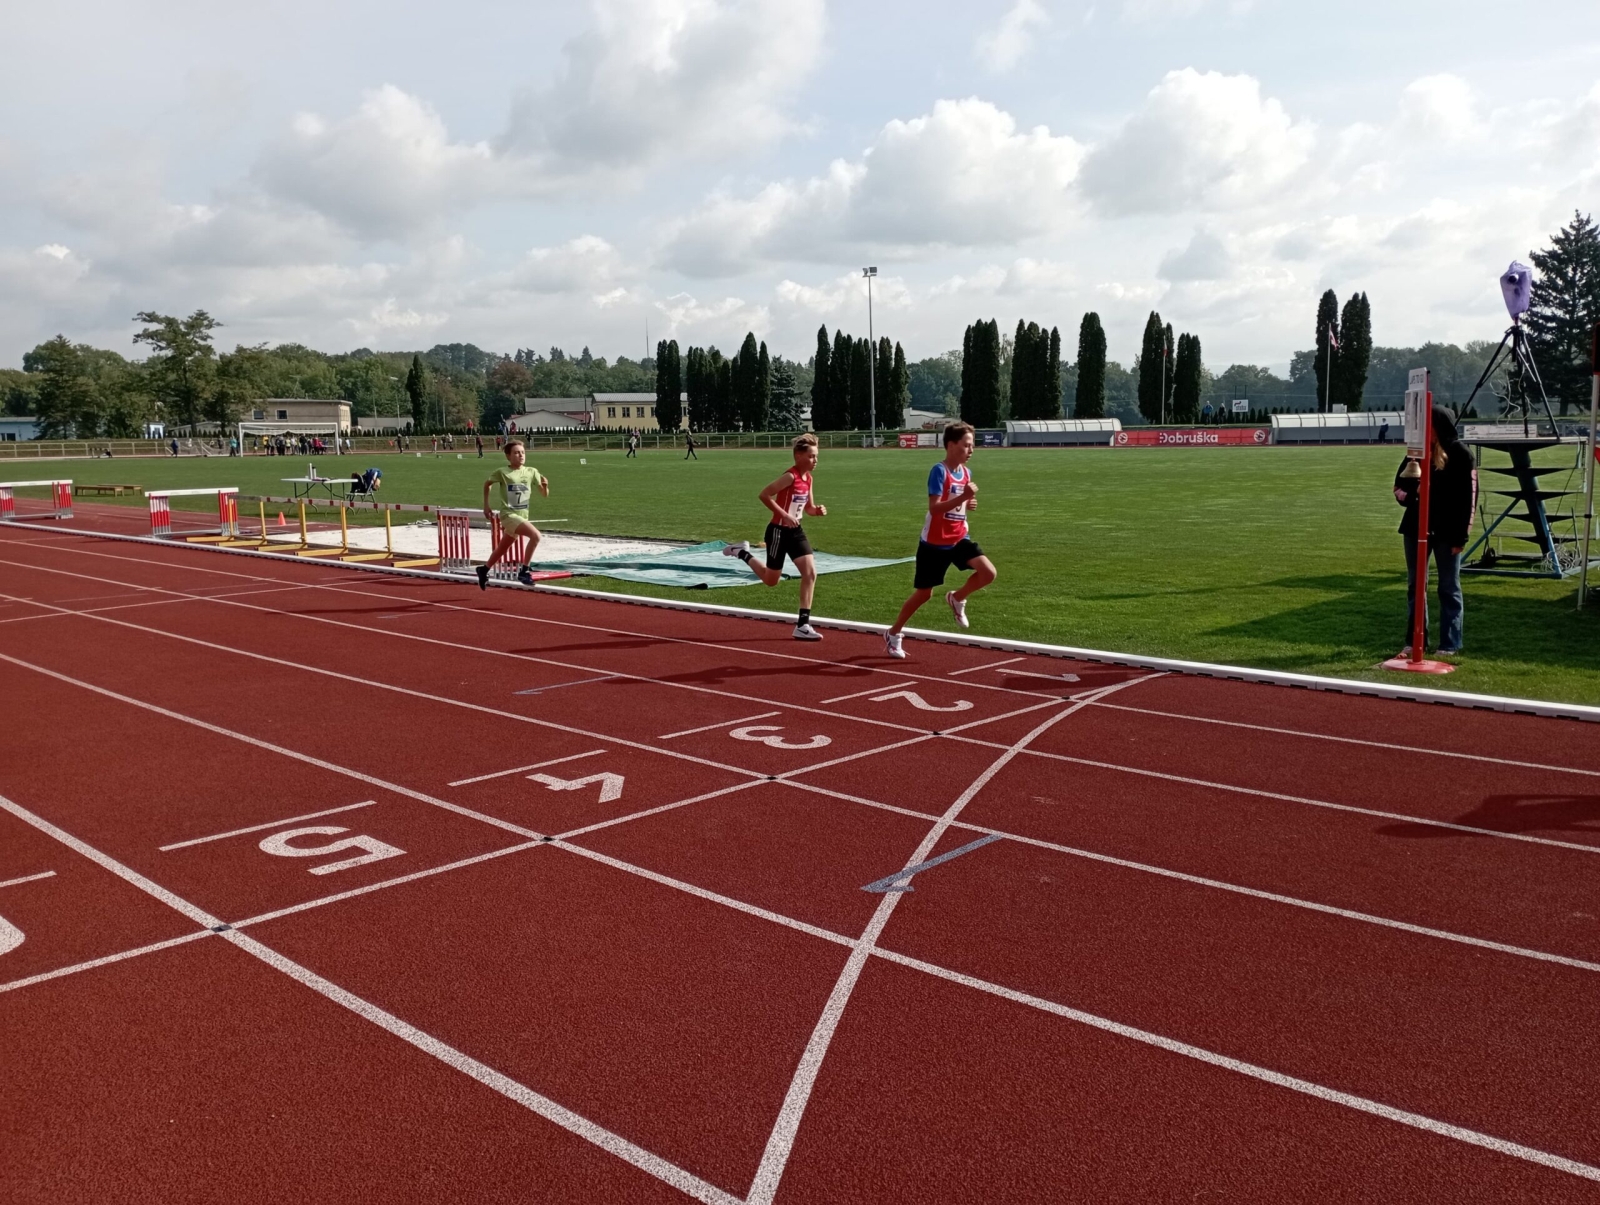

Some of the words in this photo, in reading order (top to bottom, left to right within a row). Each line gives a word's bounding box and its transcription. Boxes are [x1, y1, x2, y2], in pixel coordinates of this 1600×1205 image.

[515, 492, 522, 504] 7
[995, 668, 1081, 682] 1
[869, 690, 974, 712] 2
[729, 725, 832, 750] 3
[525, 771, 625, 803] 4
[258, 825, 407, 875] 5
